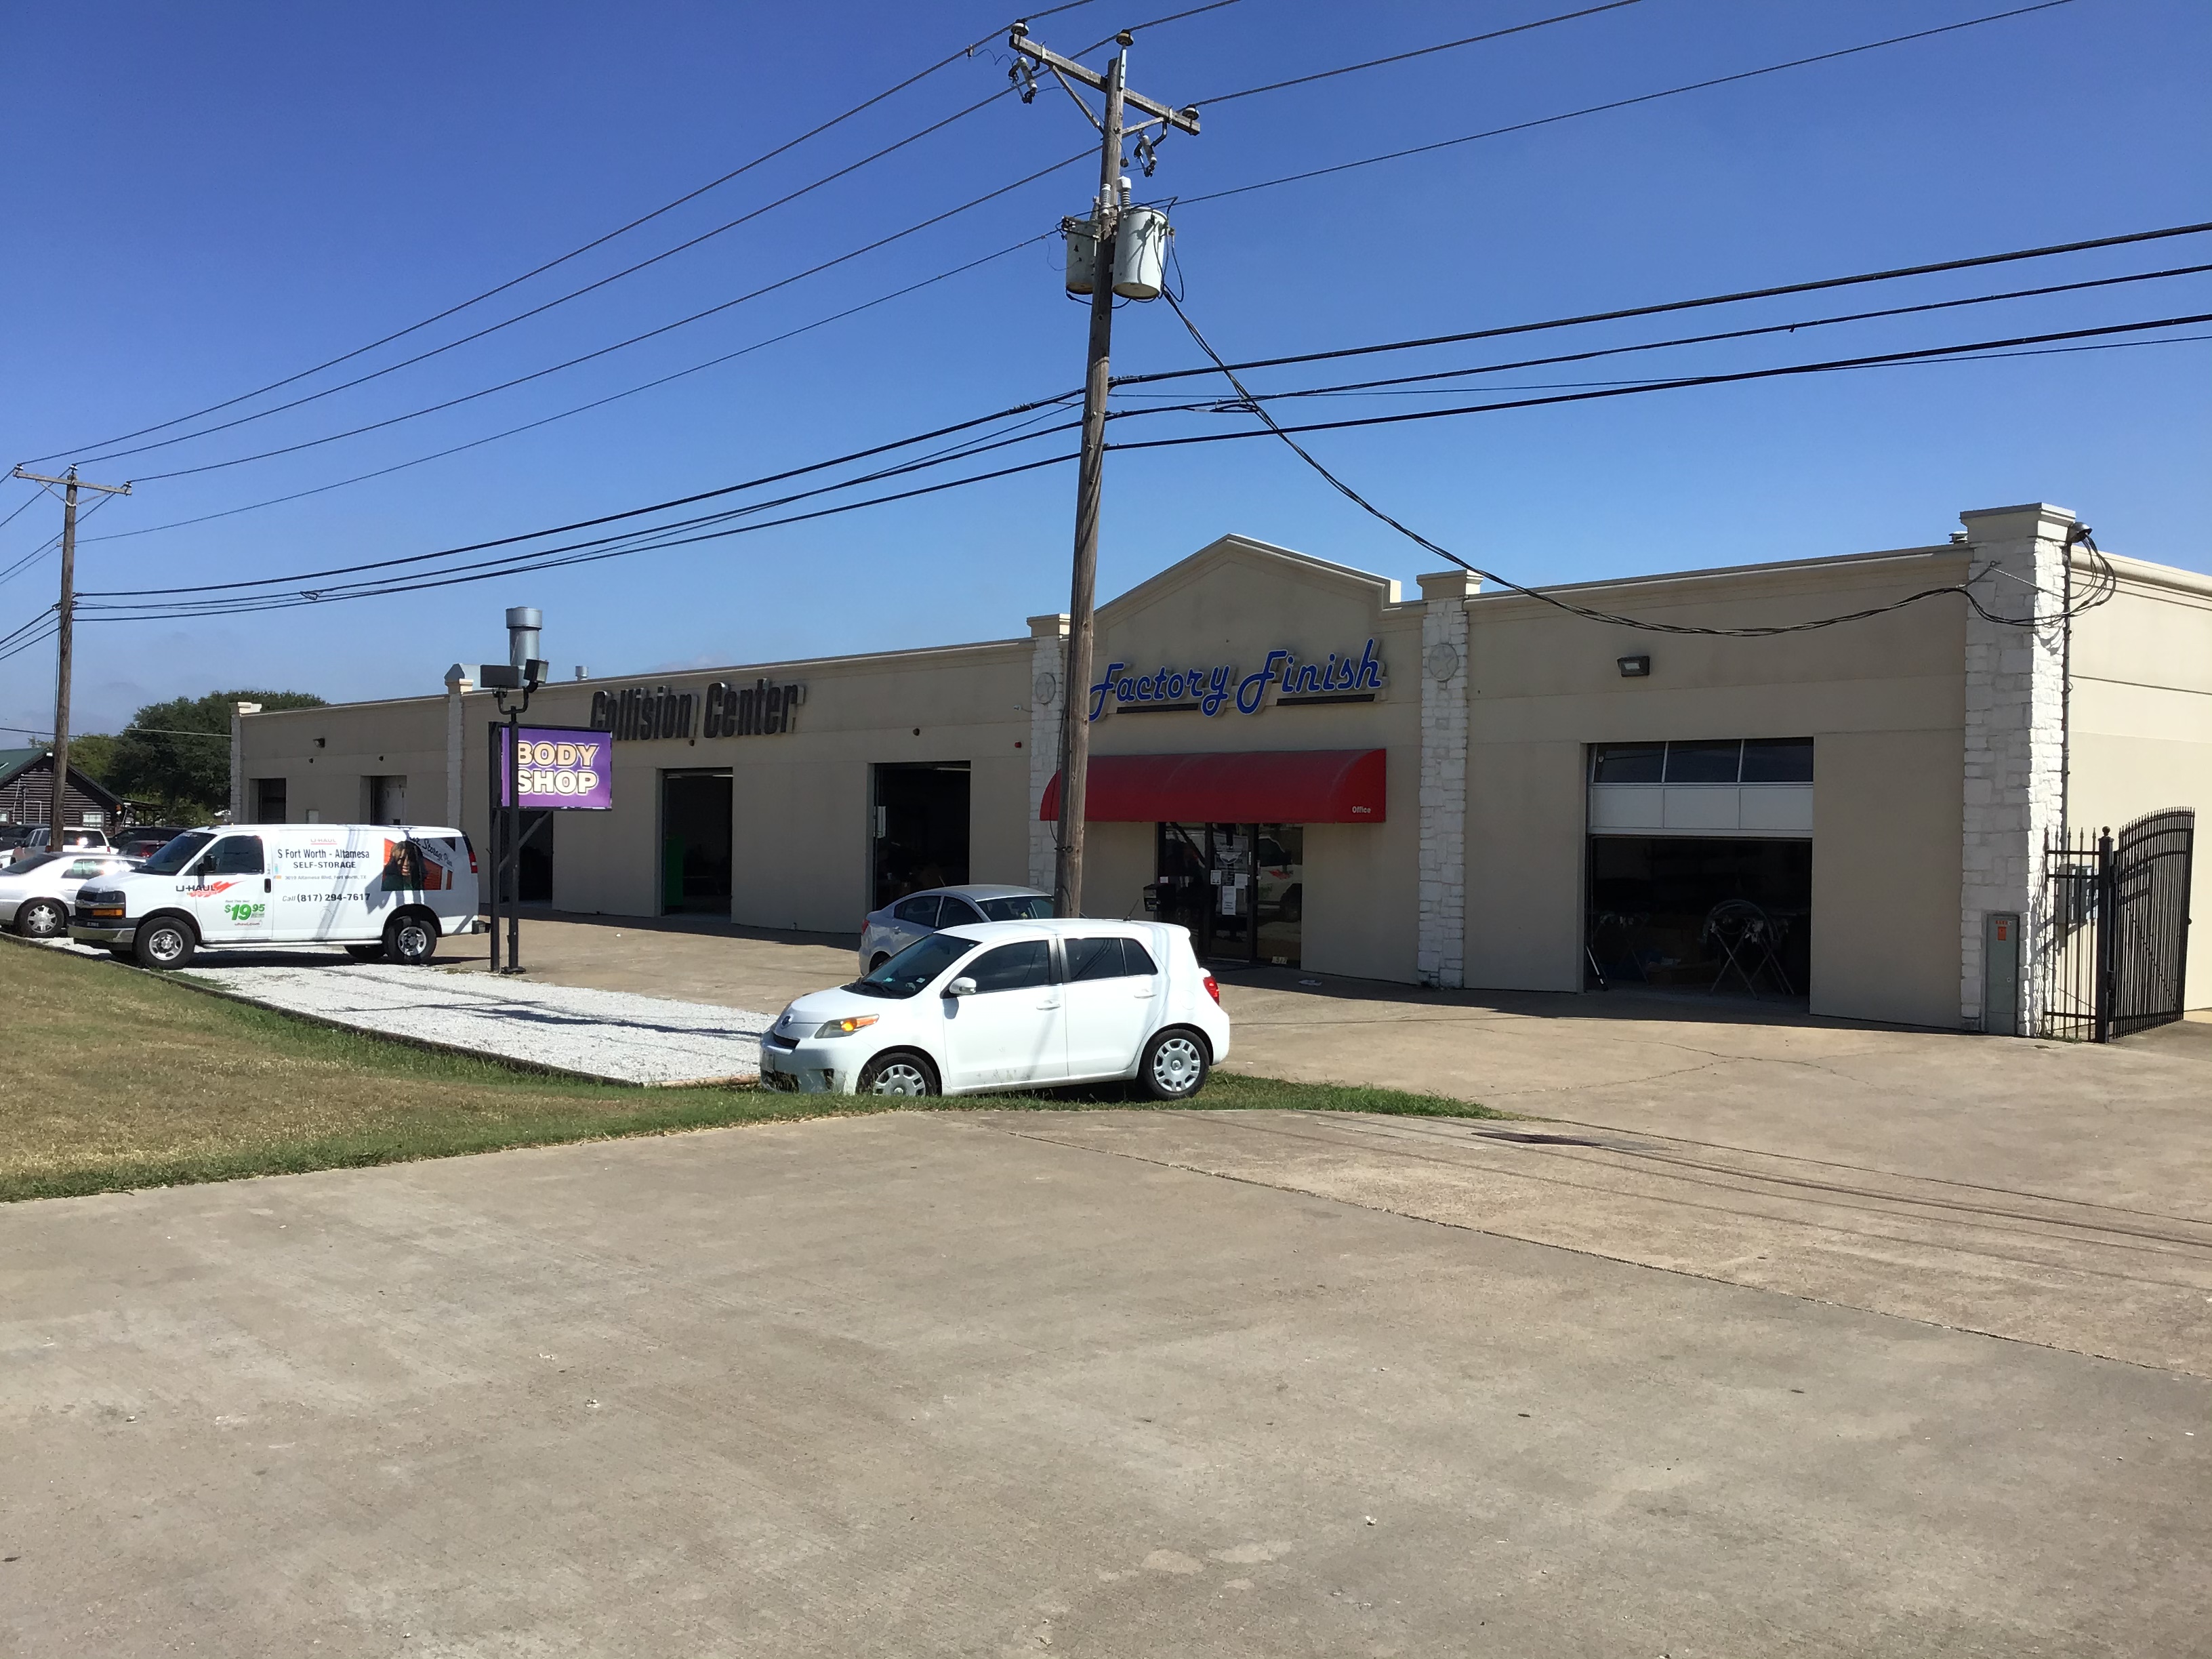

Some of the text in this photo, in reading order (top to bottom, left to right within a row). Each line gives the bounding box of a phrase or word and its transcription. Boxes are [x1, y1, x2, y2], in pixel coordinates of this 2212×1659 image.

[1089, 637, 1384, 722] Factory Finish
[590, 678, 804, 741] Collision Center
[518, 741, 599, 768] BODY
[518, 769, 599, 795] SHOP
[277, 848, 283, 859] S
[285, 848, 302, 859] Fort
[303, 848, 327, 859] Worth
[335, 848, 370, 859] Altamesa
[296, 893, 323, 903] (817)
[324, 893, 371, 902] 294-7617
